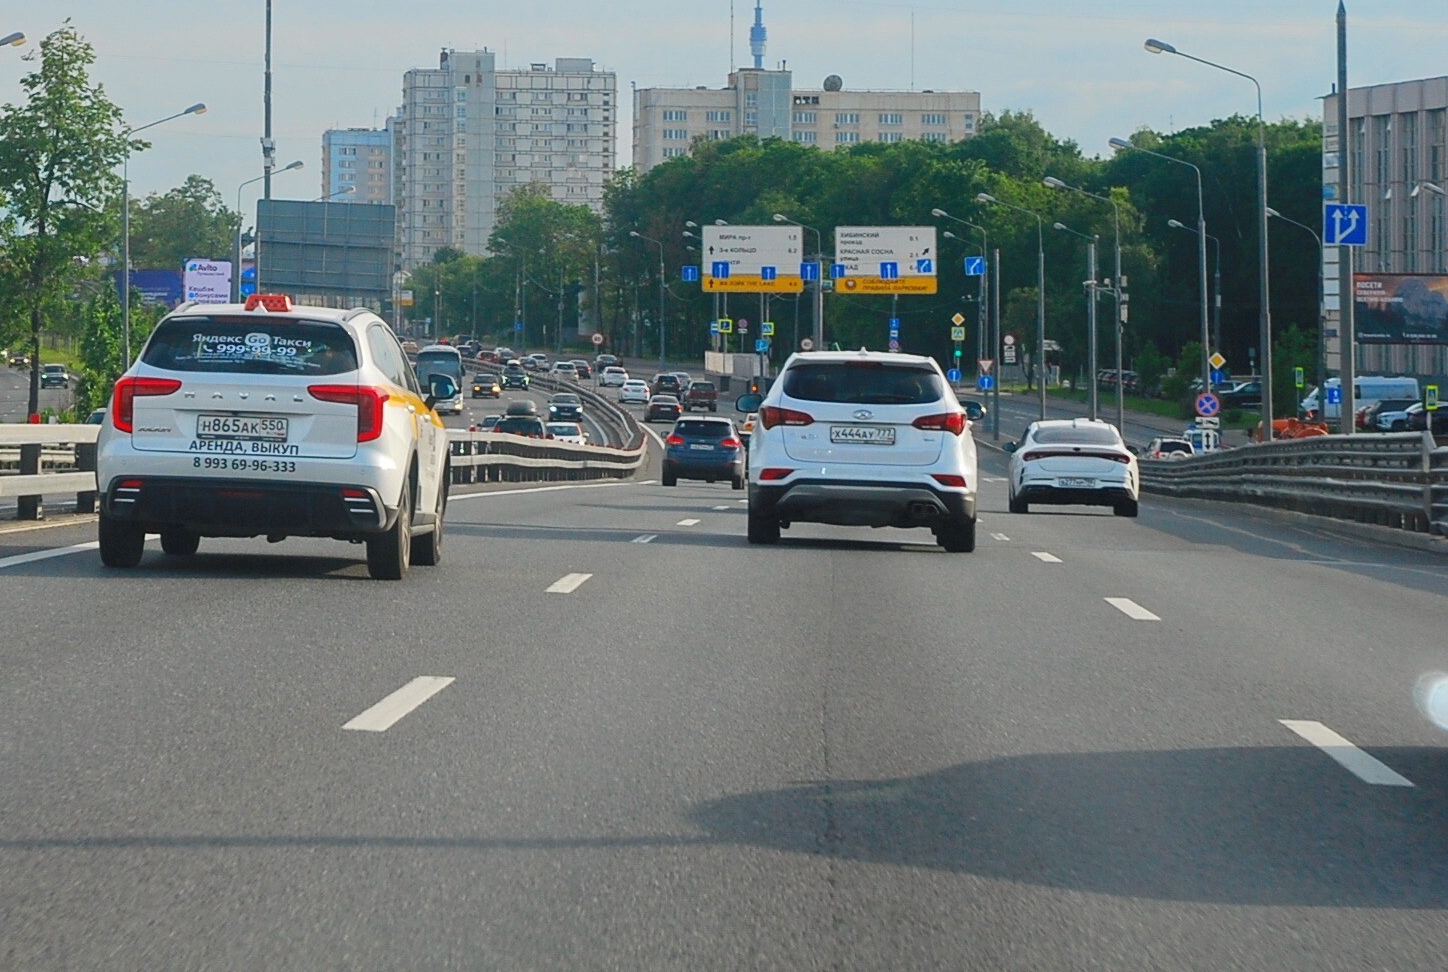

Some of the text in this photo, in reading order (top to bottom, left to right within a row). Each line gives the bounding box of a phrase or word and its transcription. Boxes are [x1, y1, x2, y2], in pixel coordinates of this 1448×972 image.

[192, 333, 311, 347] Яндекс Go Такси
[216, 344, 297, 356] 999-99-99
[261, 419, 284, 431] 550
[189, 440, 299, 455] АРЕНДА, ВЫКУП
[193, 457, 296, 472] 8 993 69-96-333
